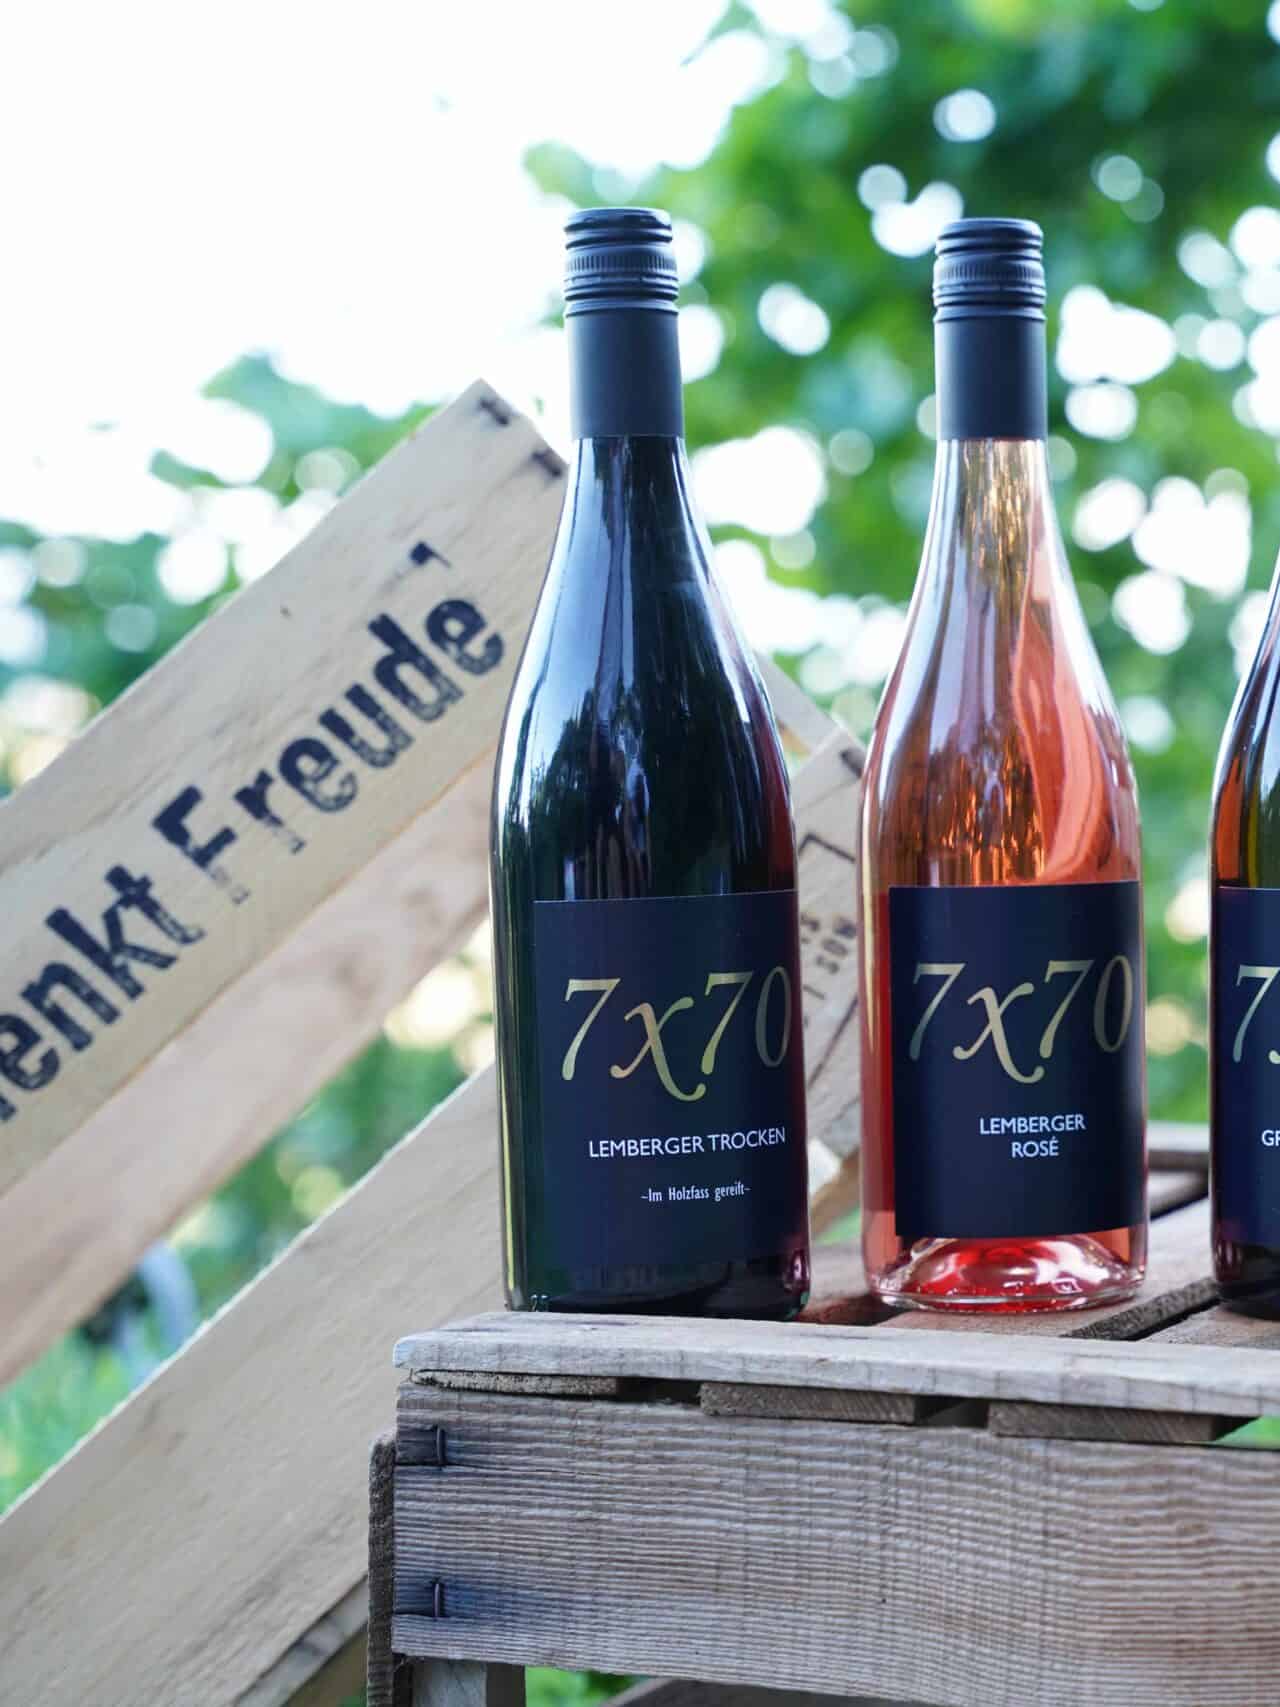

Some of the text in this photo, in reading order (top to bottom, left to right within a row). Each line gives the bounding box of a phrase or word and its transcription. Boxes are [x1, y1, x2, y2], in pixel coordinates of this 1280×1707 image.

[909, 954, 1134, 1085] 7x70
[561, 966, 791, 1102] 7x70
[980, 1114, 1086, 1134] LEMBERGER
[588, 1127, 786, 1158] LEMBERGER TROCKEN
[1012, 1136, 1060, 1158] ROSÉ
[668, 1185, 710, 1201] Holzfass
